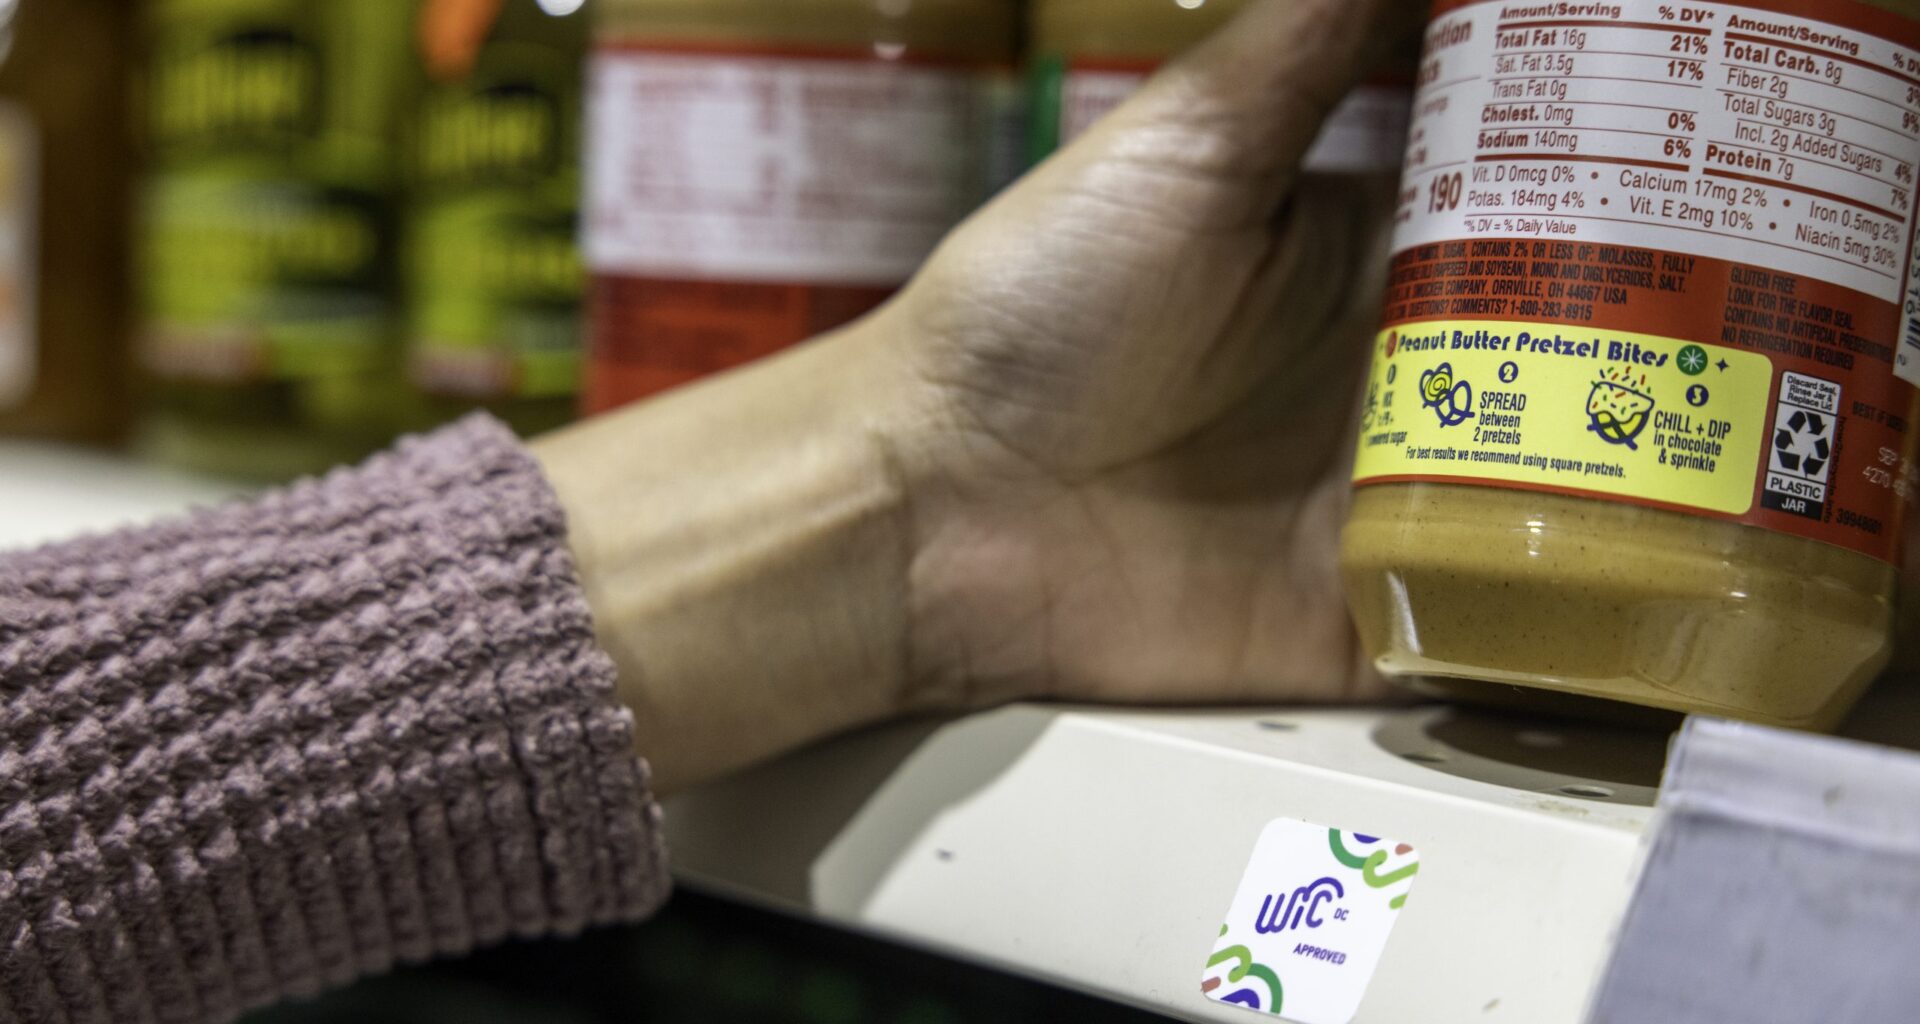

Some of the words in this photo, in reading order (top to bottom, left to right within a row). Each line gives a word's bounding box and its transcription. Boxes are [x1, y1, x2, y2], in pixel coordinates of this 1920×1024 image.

[1499, 3, 1621, 19] Amount/Serving
[1658, 6, 1675, 20] %
[1495, 30, 1528, 49] Total
[1532, 29, 1556, 46] Fat
[1562, 29, 1587, 50] 16g
[1670, 34, 1708, 55] 21%
[1727, 14, 1860, 55] Amount/Serving
[1892, 52, 1905, 69] %
[1495, 55, 1517, 74] Sat.
[1521, 54, 1541, 72] Fat
[1544, 54, 1574, 75] 3.5g
[1667, 60, 1704, 81] 17%
[1723, 41, 1769, 64] Total
[1775, 49, 1820, 75] Carb.
[1824, 61, 1843, 84] 8g
[1492, 80, 1522, 99] Trans
[1526, 79, 1546, 97] Fat
[1550, 79, 1567, 100] 0g
[1726, 67, 1766, 91] Fiber
[1769, 75, 1788, 99] 2g
[1902, 112, 1919, 134] 9%
[1481, 105, 1539, 123] Cholest.
[1544, 105, 1573, 126] 0mg
[1668, 112, 1696, 132] 0%
[1723, 93, 1759, 116] Total
[1764, 100, 1815, 127] Sugars
[1818, 112, 1836, 136] 3g
[1477, 131, 1528, 149] Sodium
[1534, 130, 1578, 152] 140mg
[1663, 138, 1691, 159] 6%
[1734, 121, 1765, 144] Incl.
[1770, 129, 1788, 152] 2g
[1792, 134, 1837, 160] Added
[1839, 144, 1882, 173] Sugars
[1894, 163, 1912, 185] 4%
[1705, 144, 1771, 172] Protein
[1777, 158, 1794, 181] 7g
[1890, 189, 1908, 211] 7%
[1428, 171, 1462, 214] 190
[1472, 166, 1490, 183] Vit.
[1494, 165, 1505, 182] D
[1508, 165, 1547, 186] 0mcg
[1551, 165, 1575, 183] 0%
[1619, 169, 1687, 194] Calcium
[1694, 178, 1737, 206] 17mg
[1741, 187, 1767, 208] 2%
[1809, 201, 1837, 224] Iron
[1841, 210, 1880, 241] 0.5mg
[1882, 223, 1900, 244] 2%
[1466, 190, 1504, 208] Potas.
[1511, 189, 1557, 212] 184mg
[1560, 191, 1585, 209] 4%
[1629, 195, 1655, 216] Vit.
[1661, 199, 1674, 218] E
[1678, 202, 1714, 228] 2mg
[1721, 208, 1753, 231] 10%
[1795, 223, 1840, 251] Niacin
[1843, 236, 1871, 264] 5mg
[1872, 245, 1896, 269] 30%
[1477, 219, 1492, 232] DV
[1516, 218, 1543, 235] Daily
[1546, 219, 1576, 234] Value
[1471, 242, 1510, 257] CONTAINS
[1513, 242, 1528, 257] 2%
[1532, 242, 1546, 258] OR
[1550, 242, 1573, 260] LESS
[1598, 247, 1656, 271] MOLASSES,
[1662, 253, 1695, 274] FULLY
[1469, 261, 1483, 276] AND
[1485, 260, 1528, 279] SOYBEAN),
[1531, 261, 1559, 279] MONO
[1560, 263, 1580, 280] AND
[1583, 265, 1655, 291] DIGLYCERIDES,
[1658, 274, 1686, 293] SALT.
[1731, 267, 1770, 289] GLUTEN
[1771, 275, 1796, 295] FREE
[1445, 280, 1489, 297] COMPANY,
[1492, 280, 1544, 298] ORRVILLE,
[1548, 283, 1564, 298] OH
[1603, 288, 1627, 304] USA
[1727, 286, 1754, 306] LOOK
[1756, 293, 1776, 311] FOR
[1779, 296, 1797, 315] THE
[1799, 300, 1833, 323] FLAVOR
[1450, 299, 1507, 314] COMMENTS?
[1724, 305, 1774, 330] CONTAINS
[1775, 317, 1790, 333] NO
[1791, 318, 1838, 347] ARTIFICIAL
[1398, 331, 1446, 352] Peanut
[1450, 330, 1511, 351] Butter
[1515, 332, 1600, 358] Pretzel
[1607, 340, 1669, 367] Bites
[1721, 325, 1737, 343] NO
[1738, 329, 1814, 360] REFRIGERATION
[1786, 375, 1818, 391] Discard
[1789, 385, 1812, 398] Rinse
[1813, 390, 1826, 401] Jar
[1479, 391, 1526, 412] SPREAD
[1787, 392, 1820, 408] Replace
[1820, 400, 1833, 411] Lid
[1479, 410, 1520, 428] between
[1654, 409, 1692, 434] CHILL
[1707, 419, 1731, 440] DIP
[1473, 426, 1481, 442] 2
[1481, 427, 1522, 446] pretzels
[1653, 430, 1664, 446] in
[1667, 433, 1722, 457] chocolate
[1405, 445, 1416, 460] For
[1417, 446, 1431, 460] best
[1431, 446, 1456, 461] results
[1457, 450, 1468, 461] we
[1470, 450, 1521, 465] recommend
[1522, 453, 1547, 471] using
[1550, 457, 1582, 473] square
[1584, 460, 1626, 478] pretzels.
[1658, 447, 1667, 464] &
[1670, 449, 1715, 473] sprinkle
[1770, 476, 1822, 499] PLASTIC
[1781, 498, 1806, 513] JAR
[1333, 907, 1349, 921] DC
[1293, 942, 1347, 965] APPROVED
